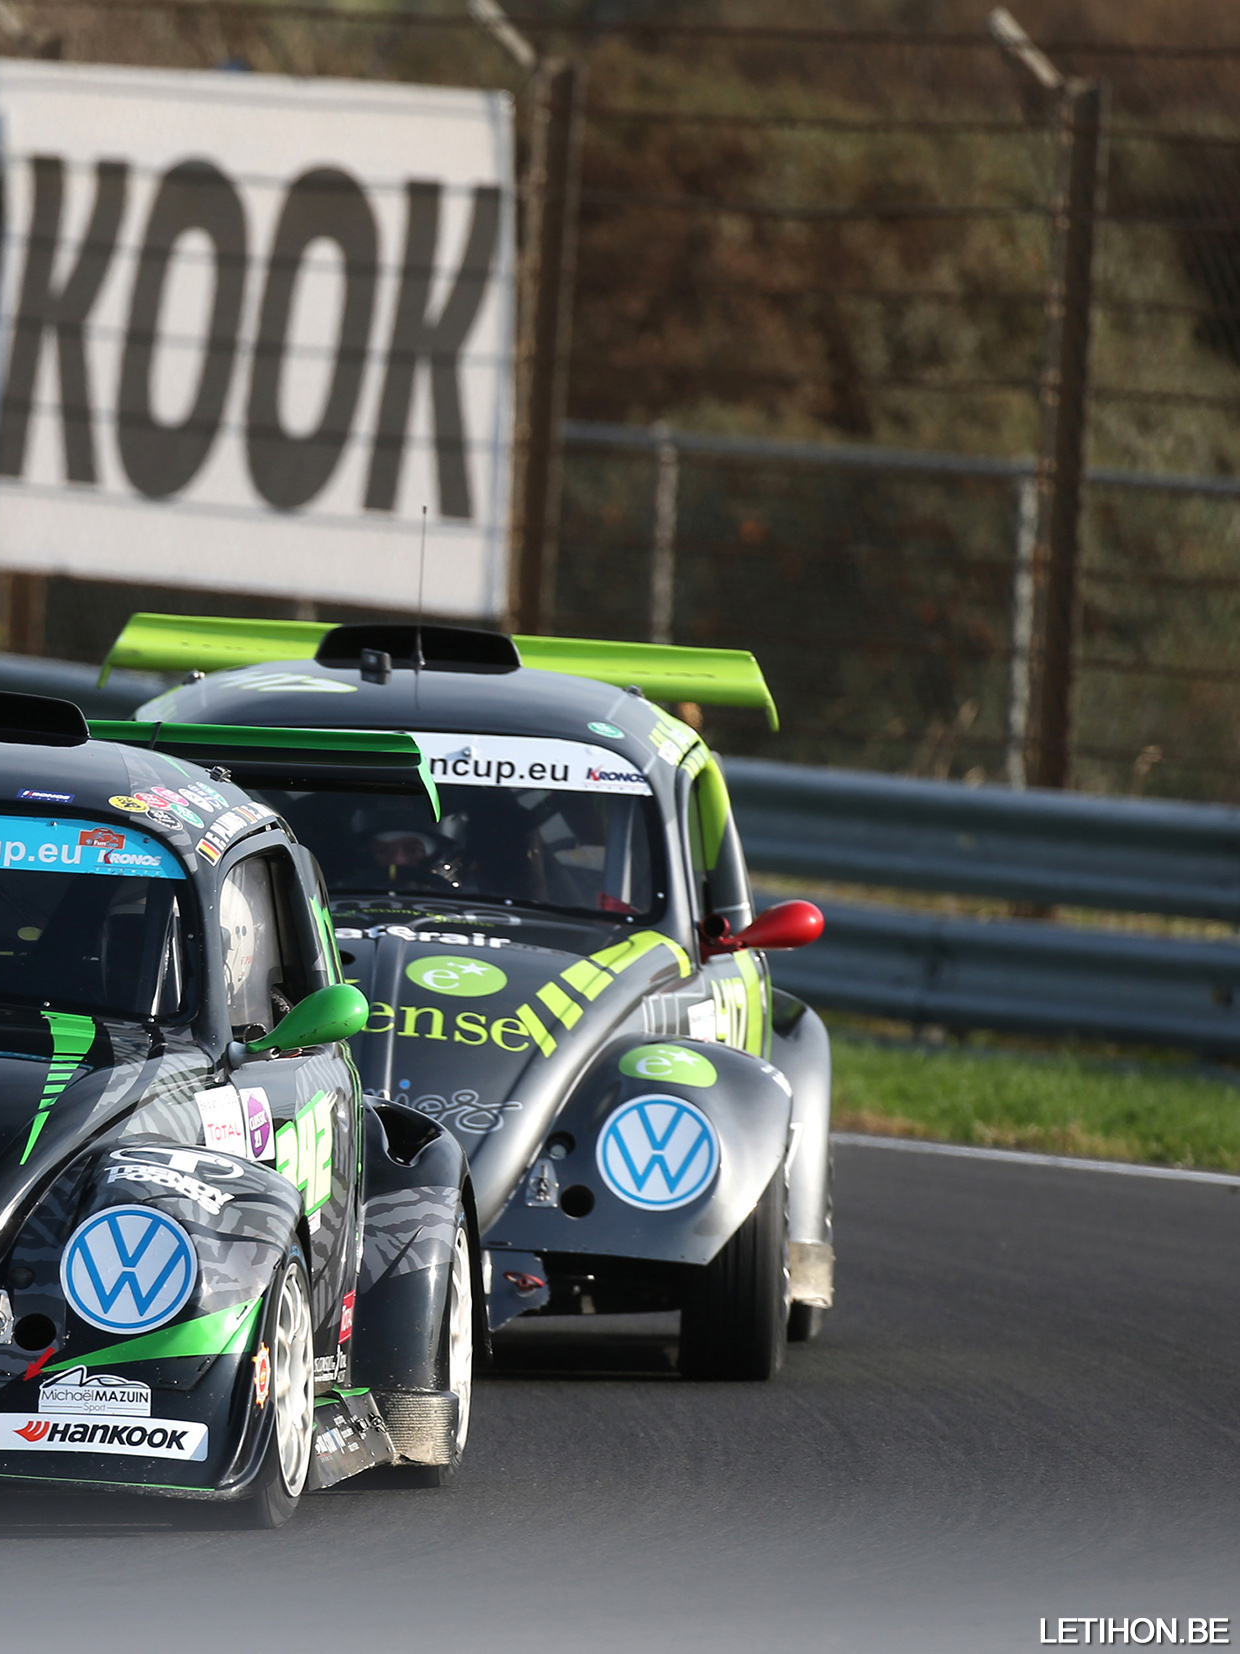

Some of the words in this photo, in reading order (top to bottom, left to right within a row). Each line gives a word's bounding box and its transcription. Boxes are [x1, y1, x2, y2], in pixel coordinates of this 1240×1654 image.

[429, 756, 570, 785] ncup.eu
[97, 849, 162, 867] KRONOS
[334, 925, 511, 949] aferair
[361, 1001, 530, 1052] ense
[207, 1122, 241, 1141] TOTAL
[104, 1164, 236, 1206] TRENDY
[107, 1173, 221, 1216] FOODS
[82, 1402, 106, 1412] Sport
